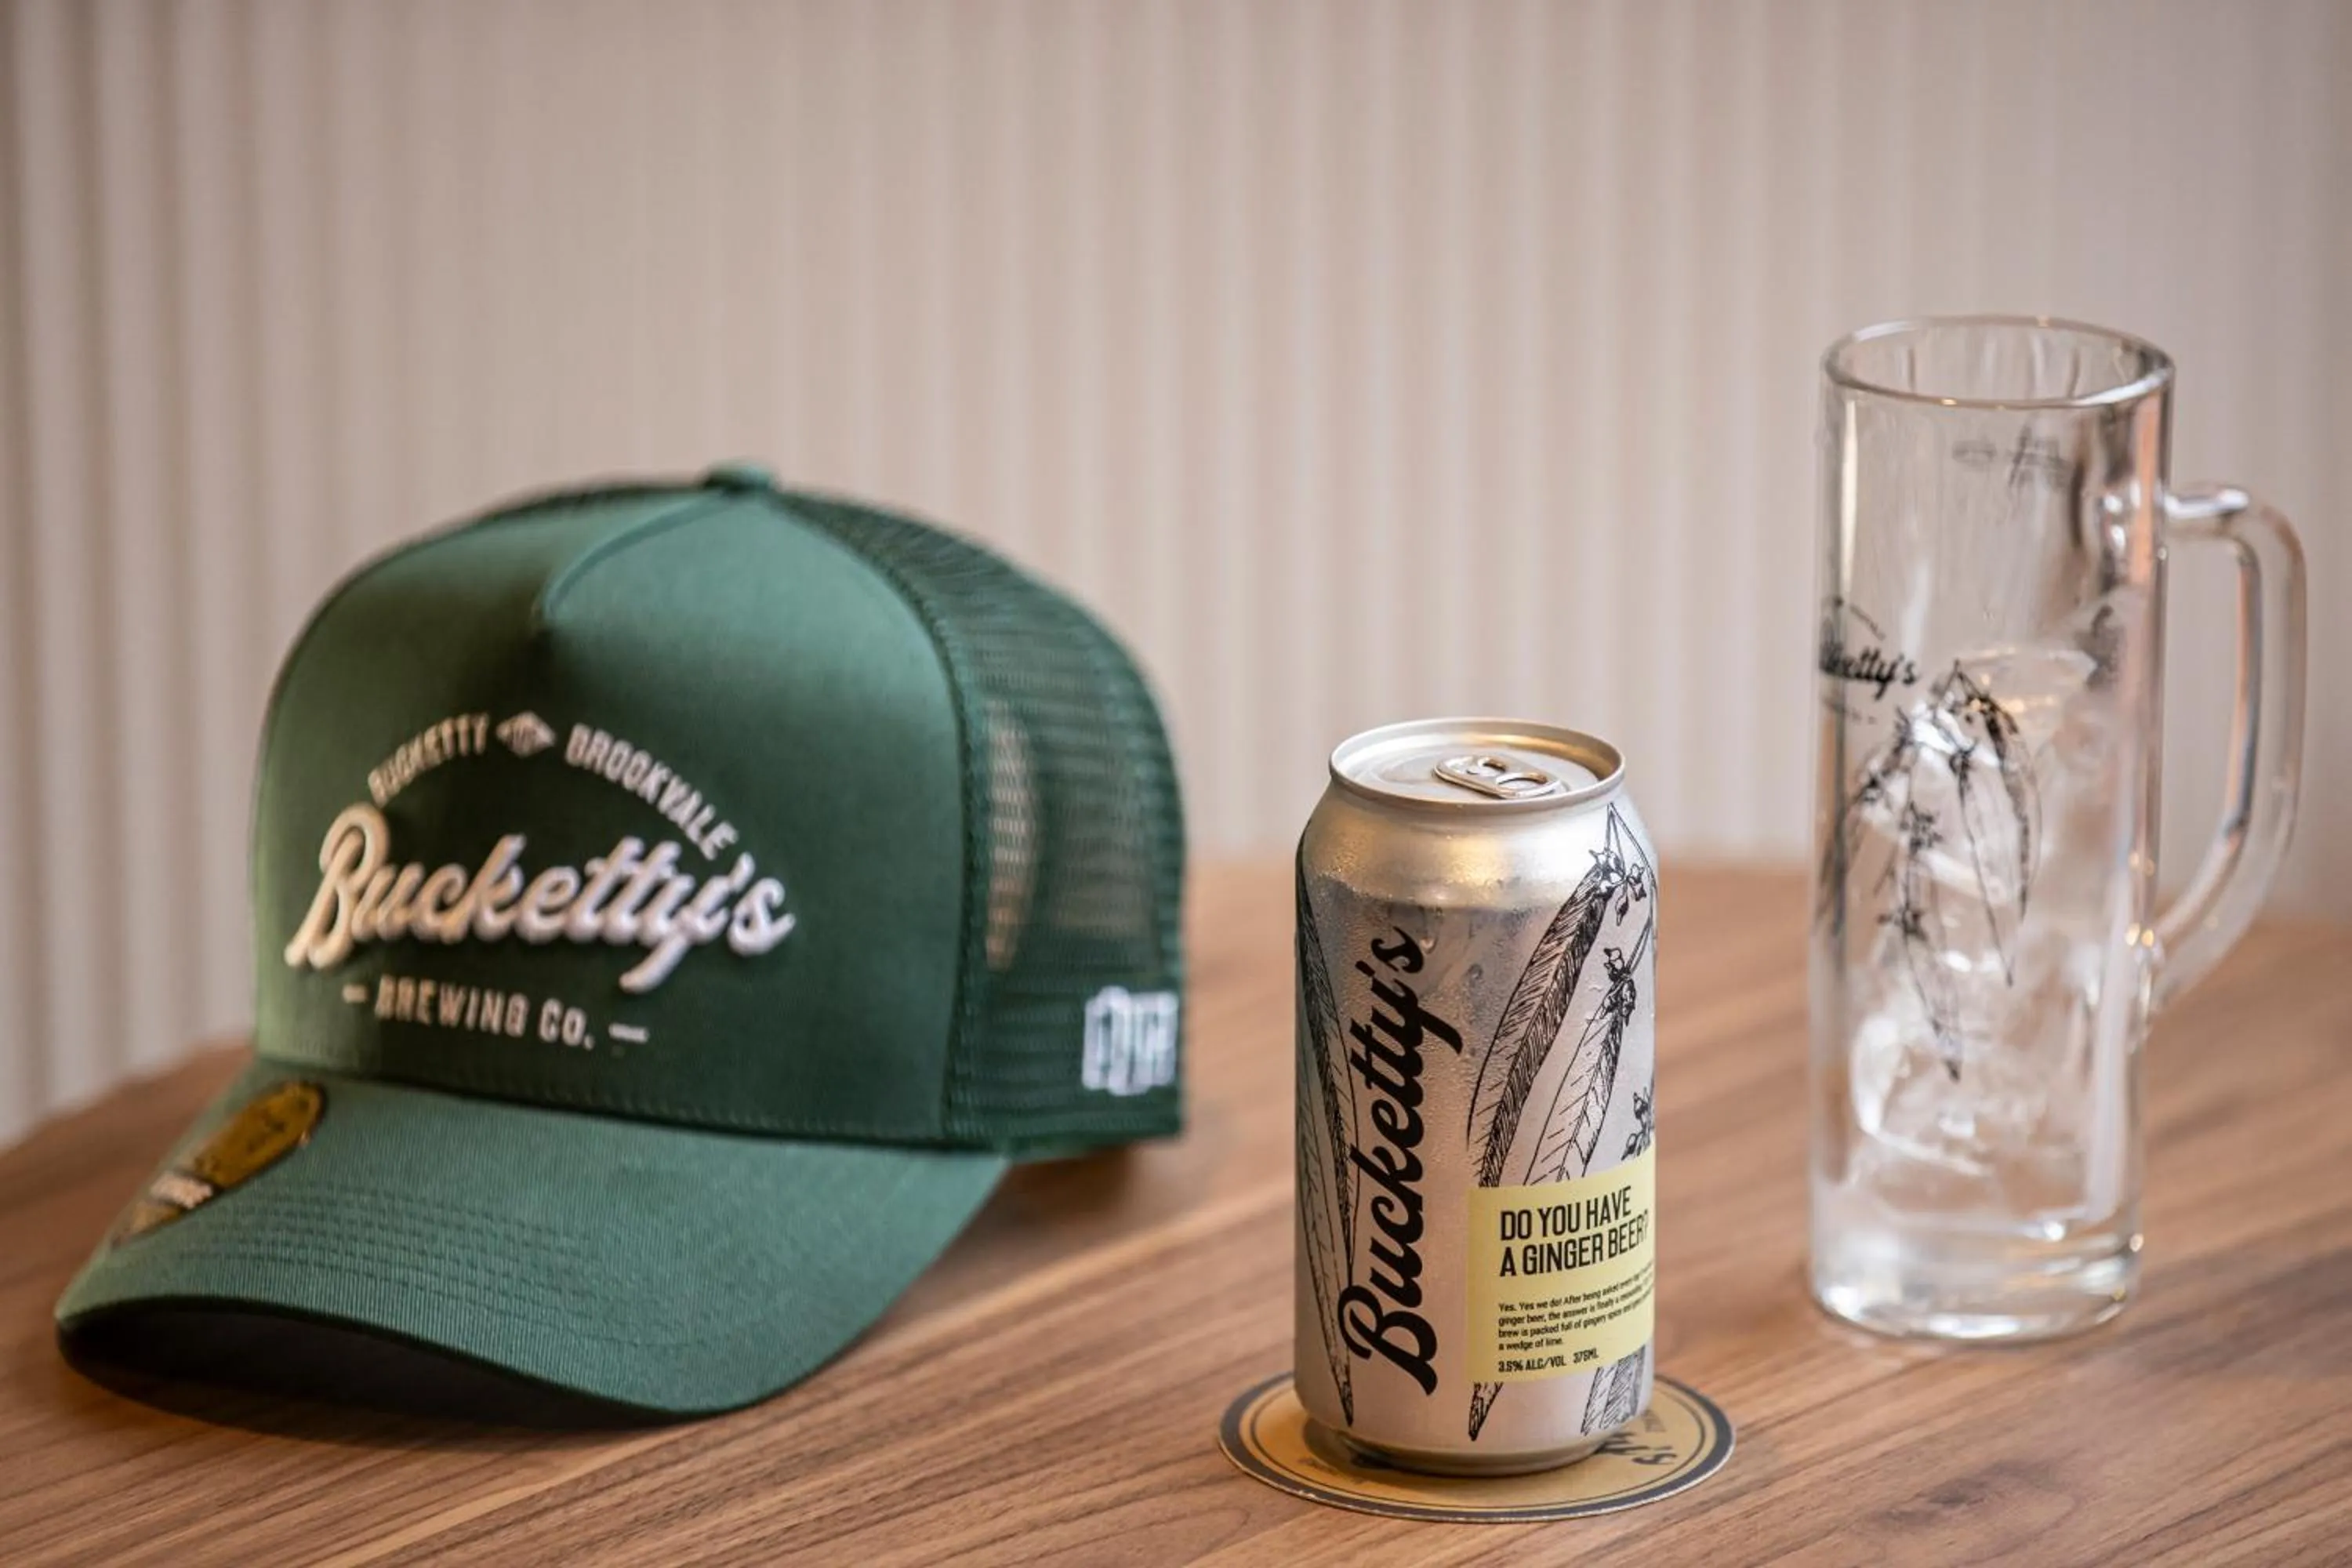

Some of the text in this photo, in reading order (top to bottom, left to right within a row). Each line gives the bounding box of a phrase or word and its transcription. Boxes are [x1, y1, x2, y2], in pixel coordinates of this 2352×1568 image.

[564, 722, 739, 861] BROOKVALE
[285, 802, 796, 993] Bucketty's
[375, 974, 594, 1051] BREWING CO.
[1338, 926, 1464, 1396] Bucketty's
[1501, 1185, 1632, 1241] DO YOU HAVE
[1500, 1247, 1516, 1276] A
[1523, 1232, 1603, 1275] GINGER
[1498, 1302, 1516, 1312] Yes.
[1519, 1301, 1534, 1311] Yes
[1498, 1316, 1525, 1327] ginger
[1526, 1313, 1547, 1323] beer,
[1498, 1328, 1519, 1338] brew
[1530, 1323, 1559, 1338] packed
[1506, 1340, 1534, 1351] wedge
[1526, 1355, 1567, 1370] ALC/VOL
[1573, 1348, 1599, 1363] 375ML
